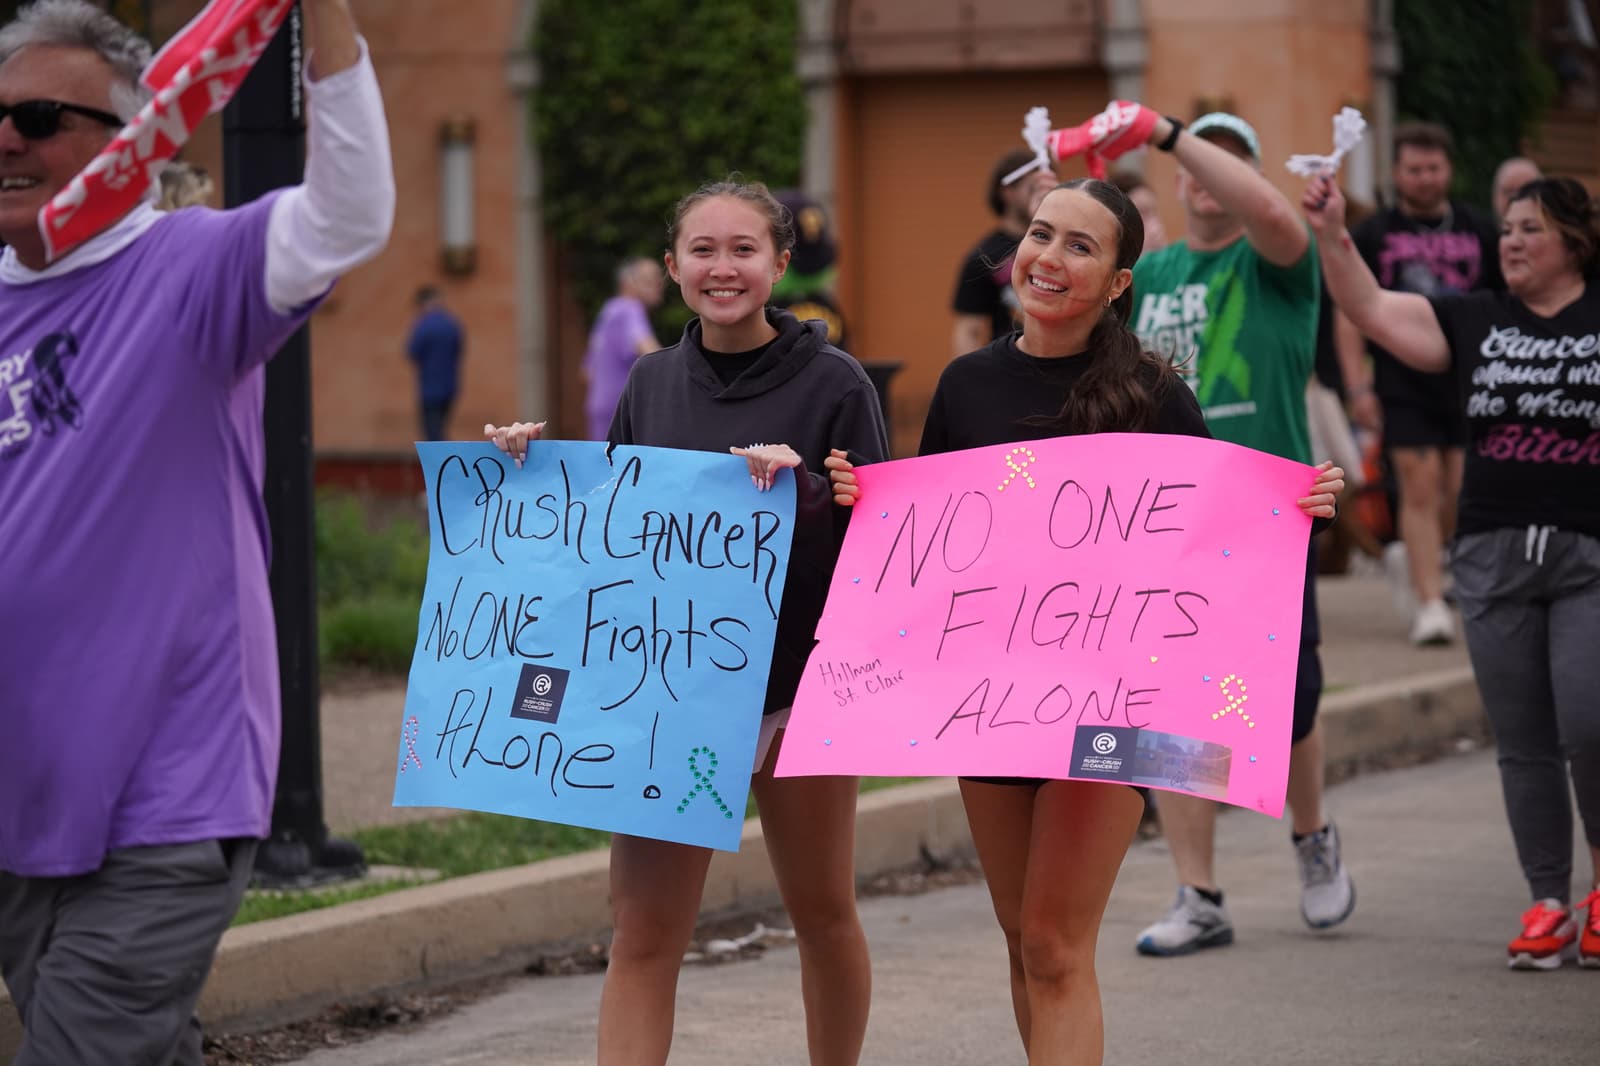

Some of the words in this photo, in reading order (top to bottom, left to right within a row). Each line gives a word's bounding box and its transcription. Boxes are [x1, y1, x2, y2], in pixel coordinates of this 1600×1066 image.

[1479, 324, 1600, 359] Cance
[875, 490, 994, 593] NO
[1048, 478, 1197, 549] ONE
[936, 581, 1209, 661] FIGHTS
[818, 658, 882, 687] Hillman
[833, 687, 860, 708] St.
[864, 668, 905, 695] Clair
[934, 676, 1161, 741] ALONE
